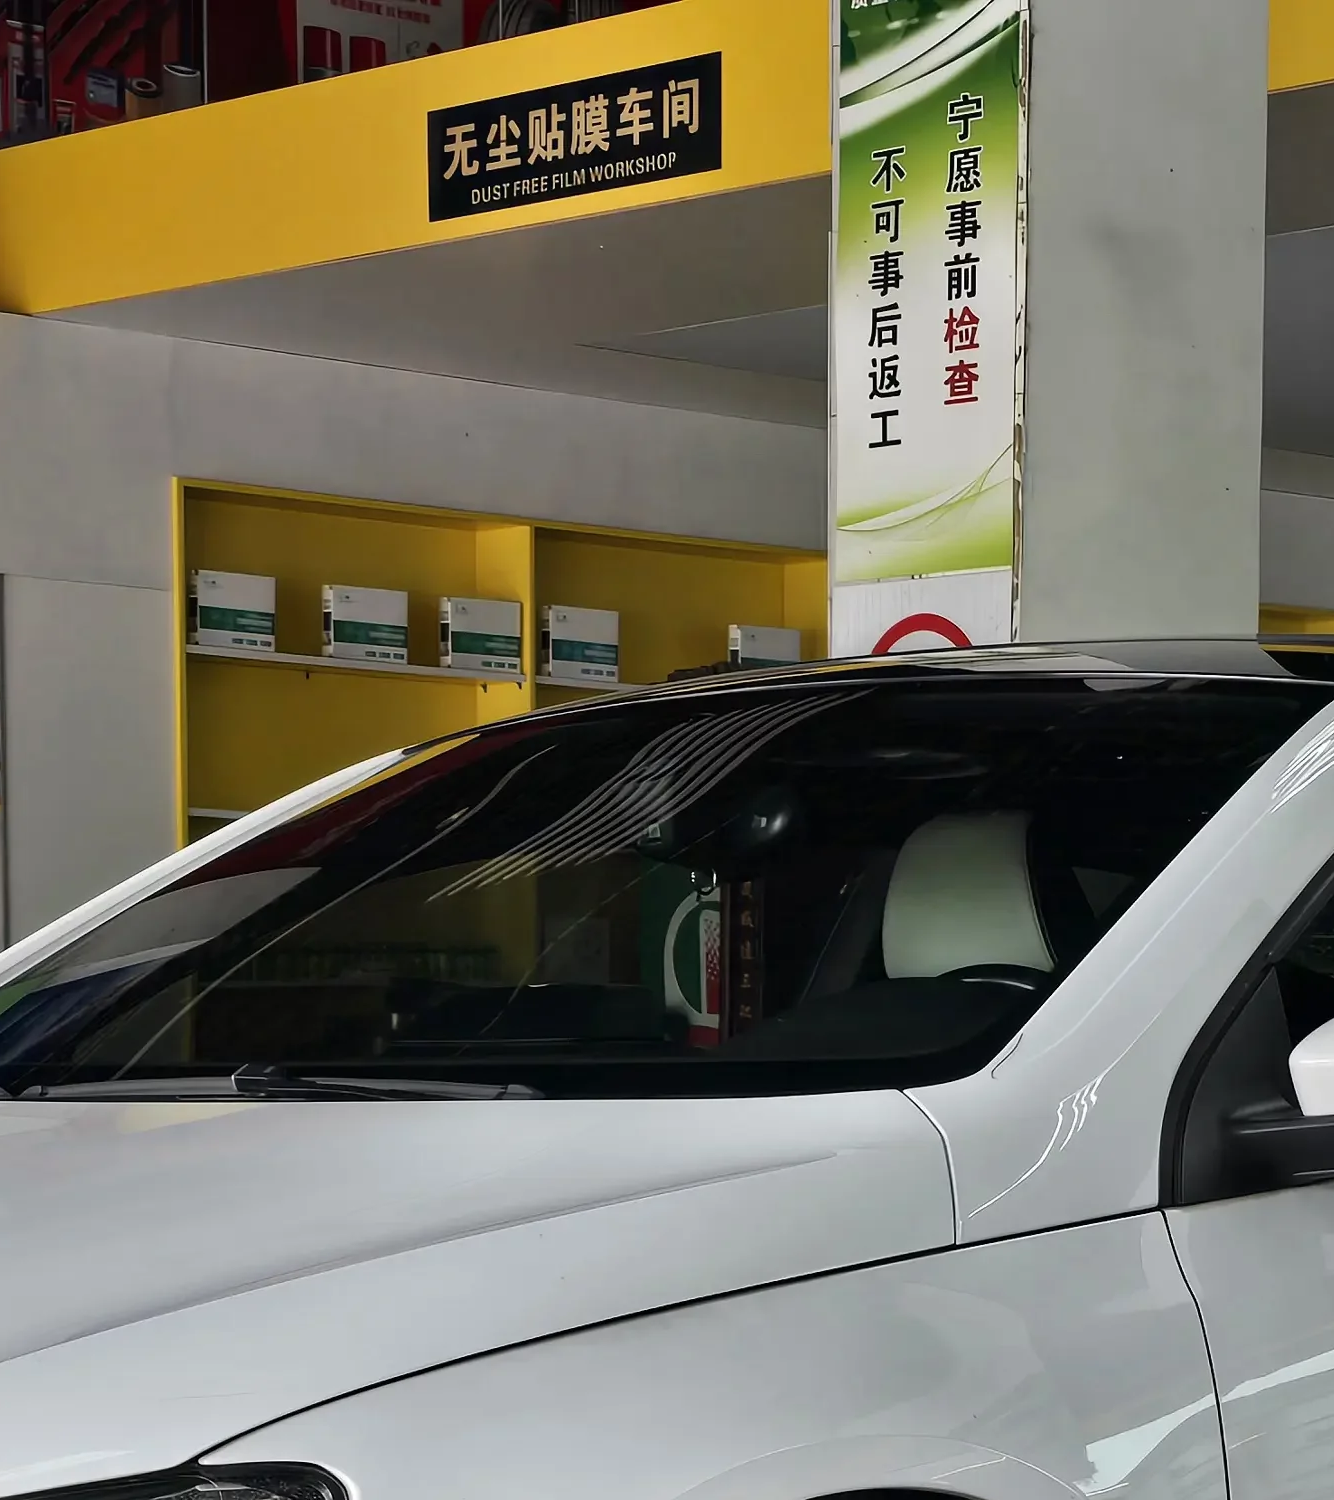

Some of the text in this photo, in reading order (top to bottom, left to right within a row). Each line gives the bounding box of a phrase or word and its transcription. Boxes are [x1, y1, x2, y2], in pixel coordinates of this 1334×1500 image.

[442, 78, 700, 180] 无尘贴膜车间
[470, 151, 676, 205] DUST FREE FILM WORKSHOP
[868, 146, 906, 450] 不可事后返工
[942, 93, 984, 407] 宁愿事前检查
